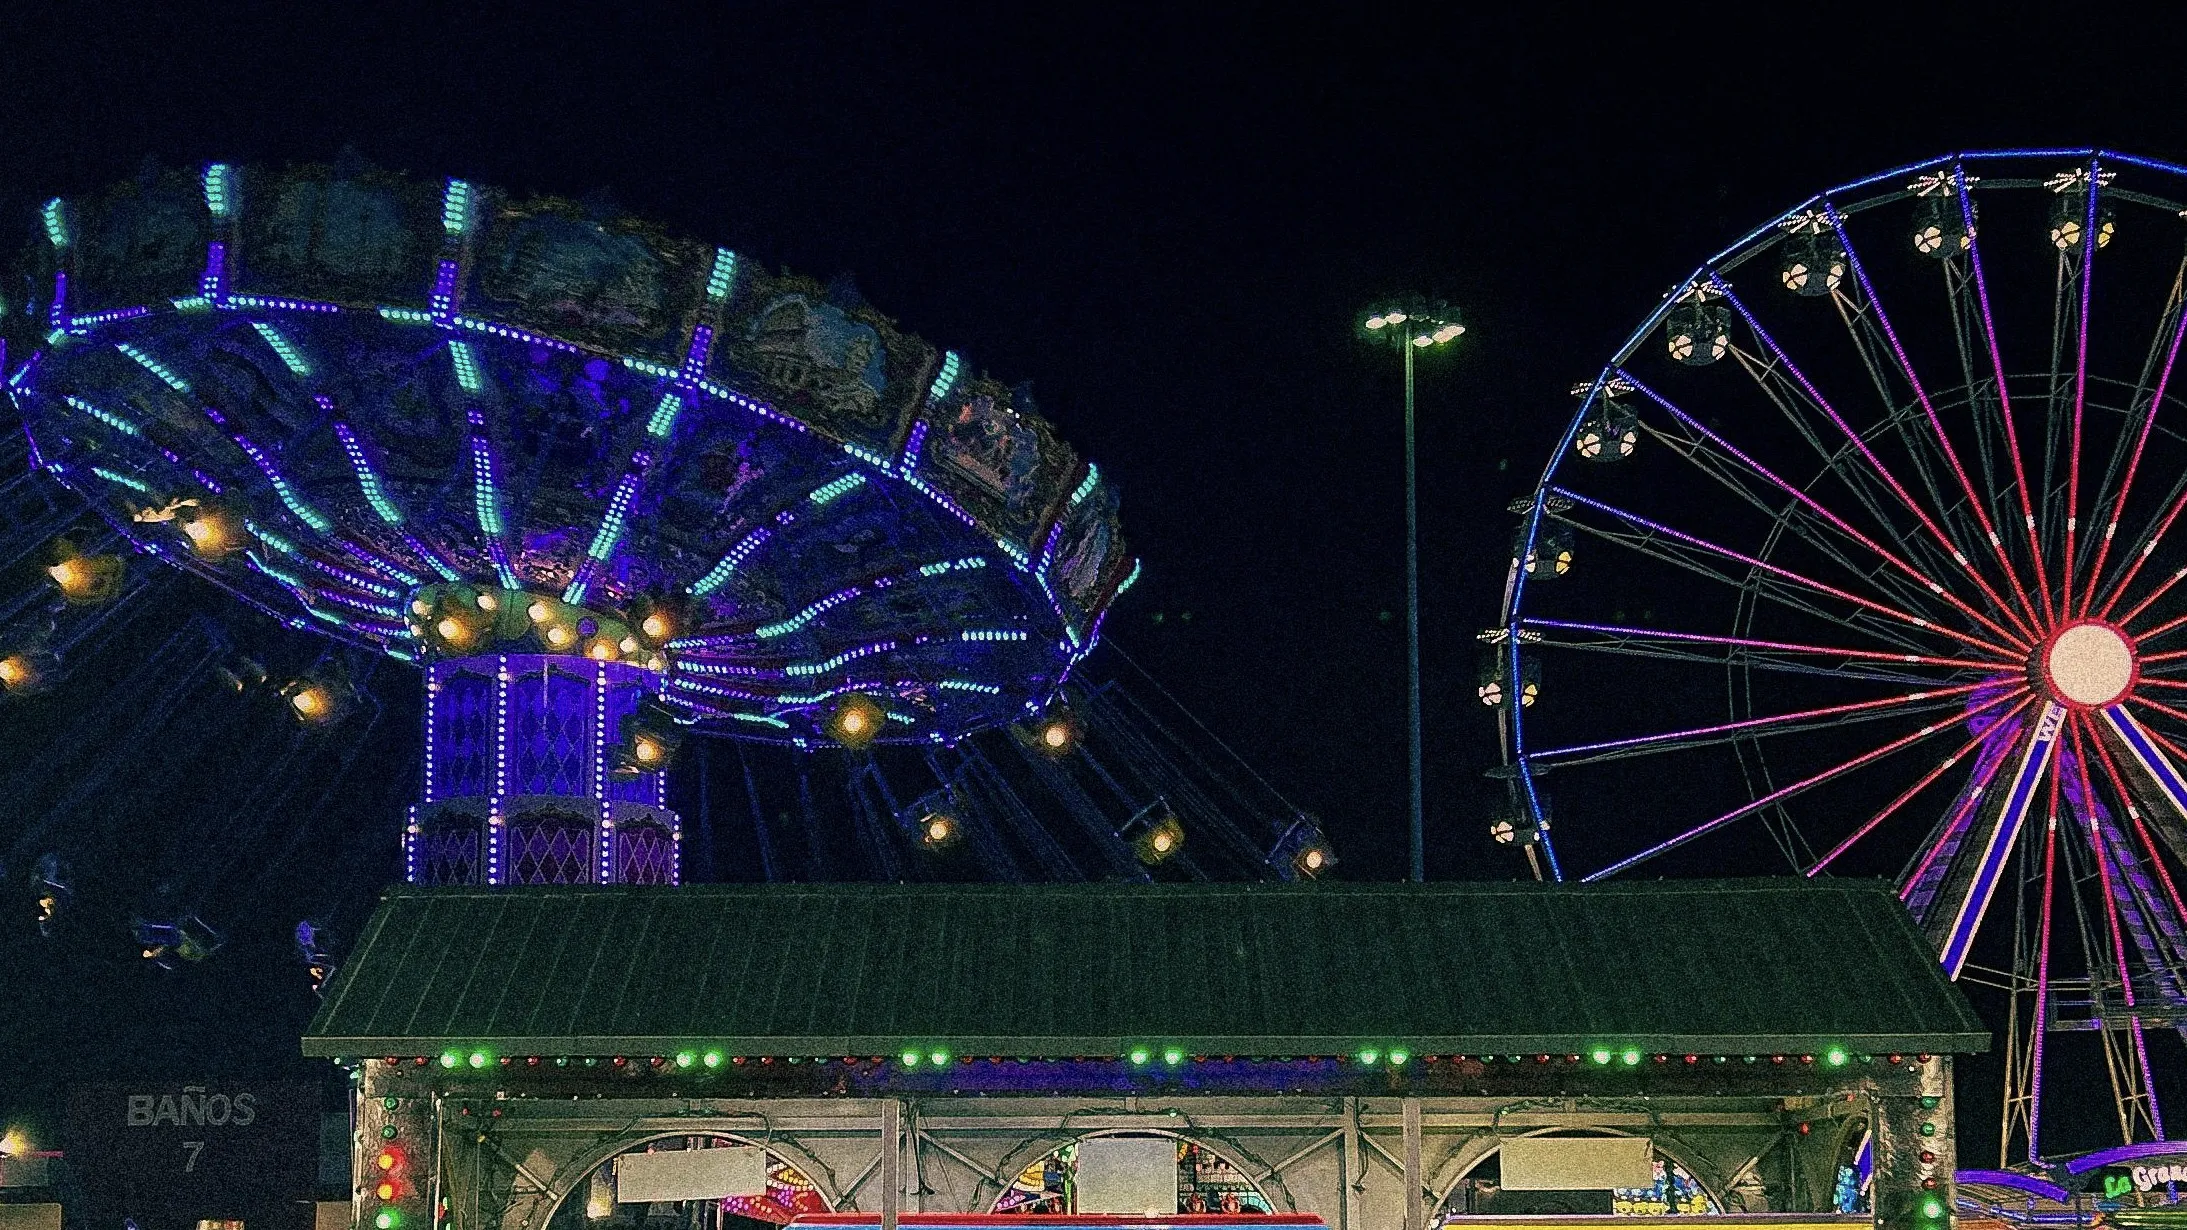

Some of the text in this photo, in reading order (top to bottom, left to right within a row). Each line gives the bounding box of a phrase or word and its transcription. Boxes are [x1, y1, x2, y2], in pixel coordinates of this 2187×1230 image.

[127, 1086, 256, 1126] BAÑOS
[183, 1141, 204, 1172] 7
[2105, 1177, 2132, 1199] La
